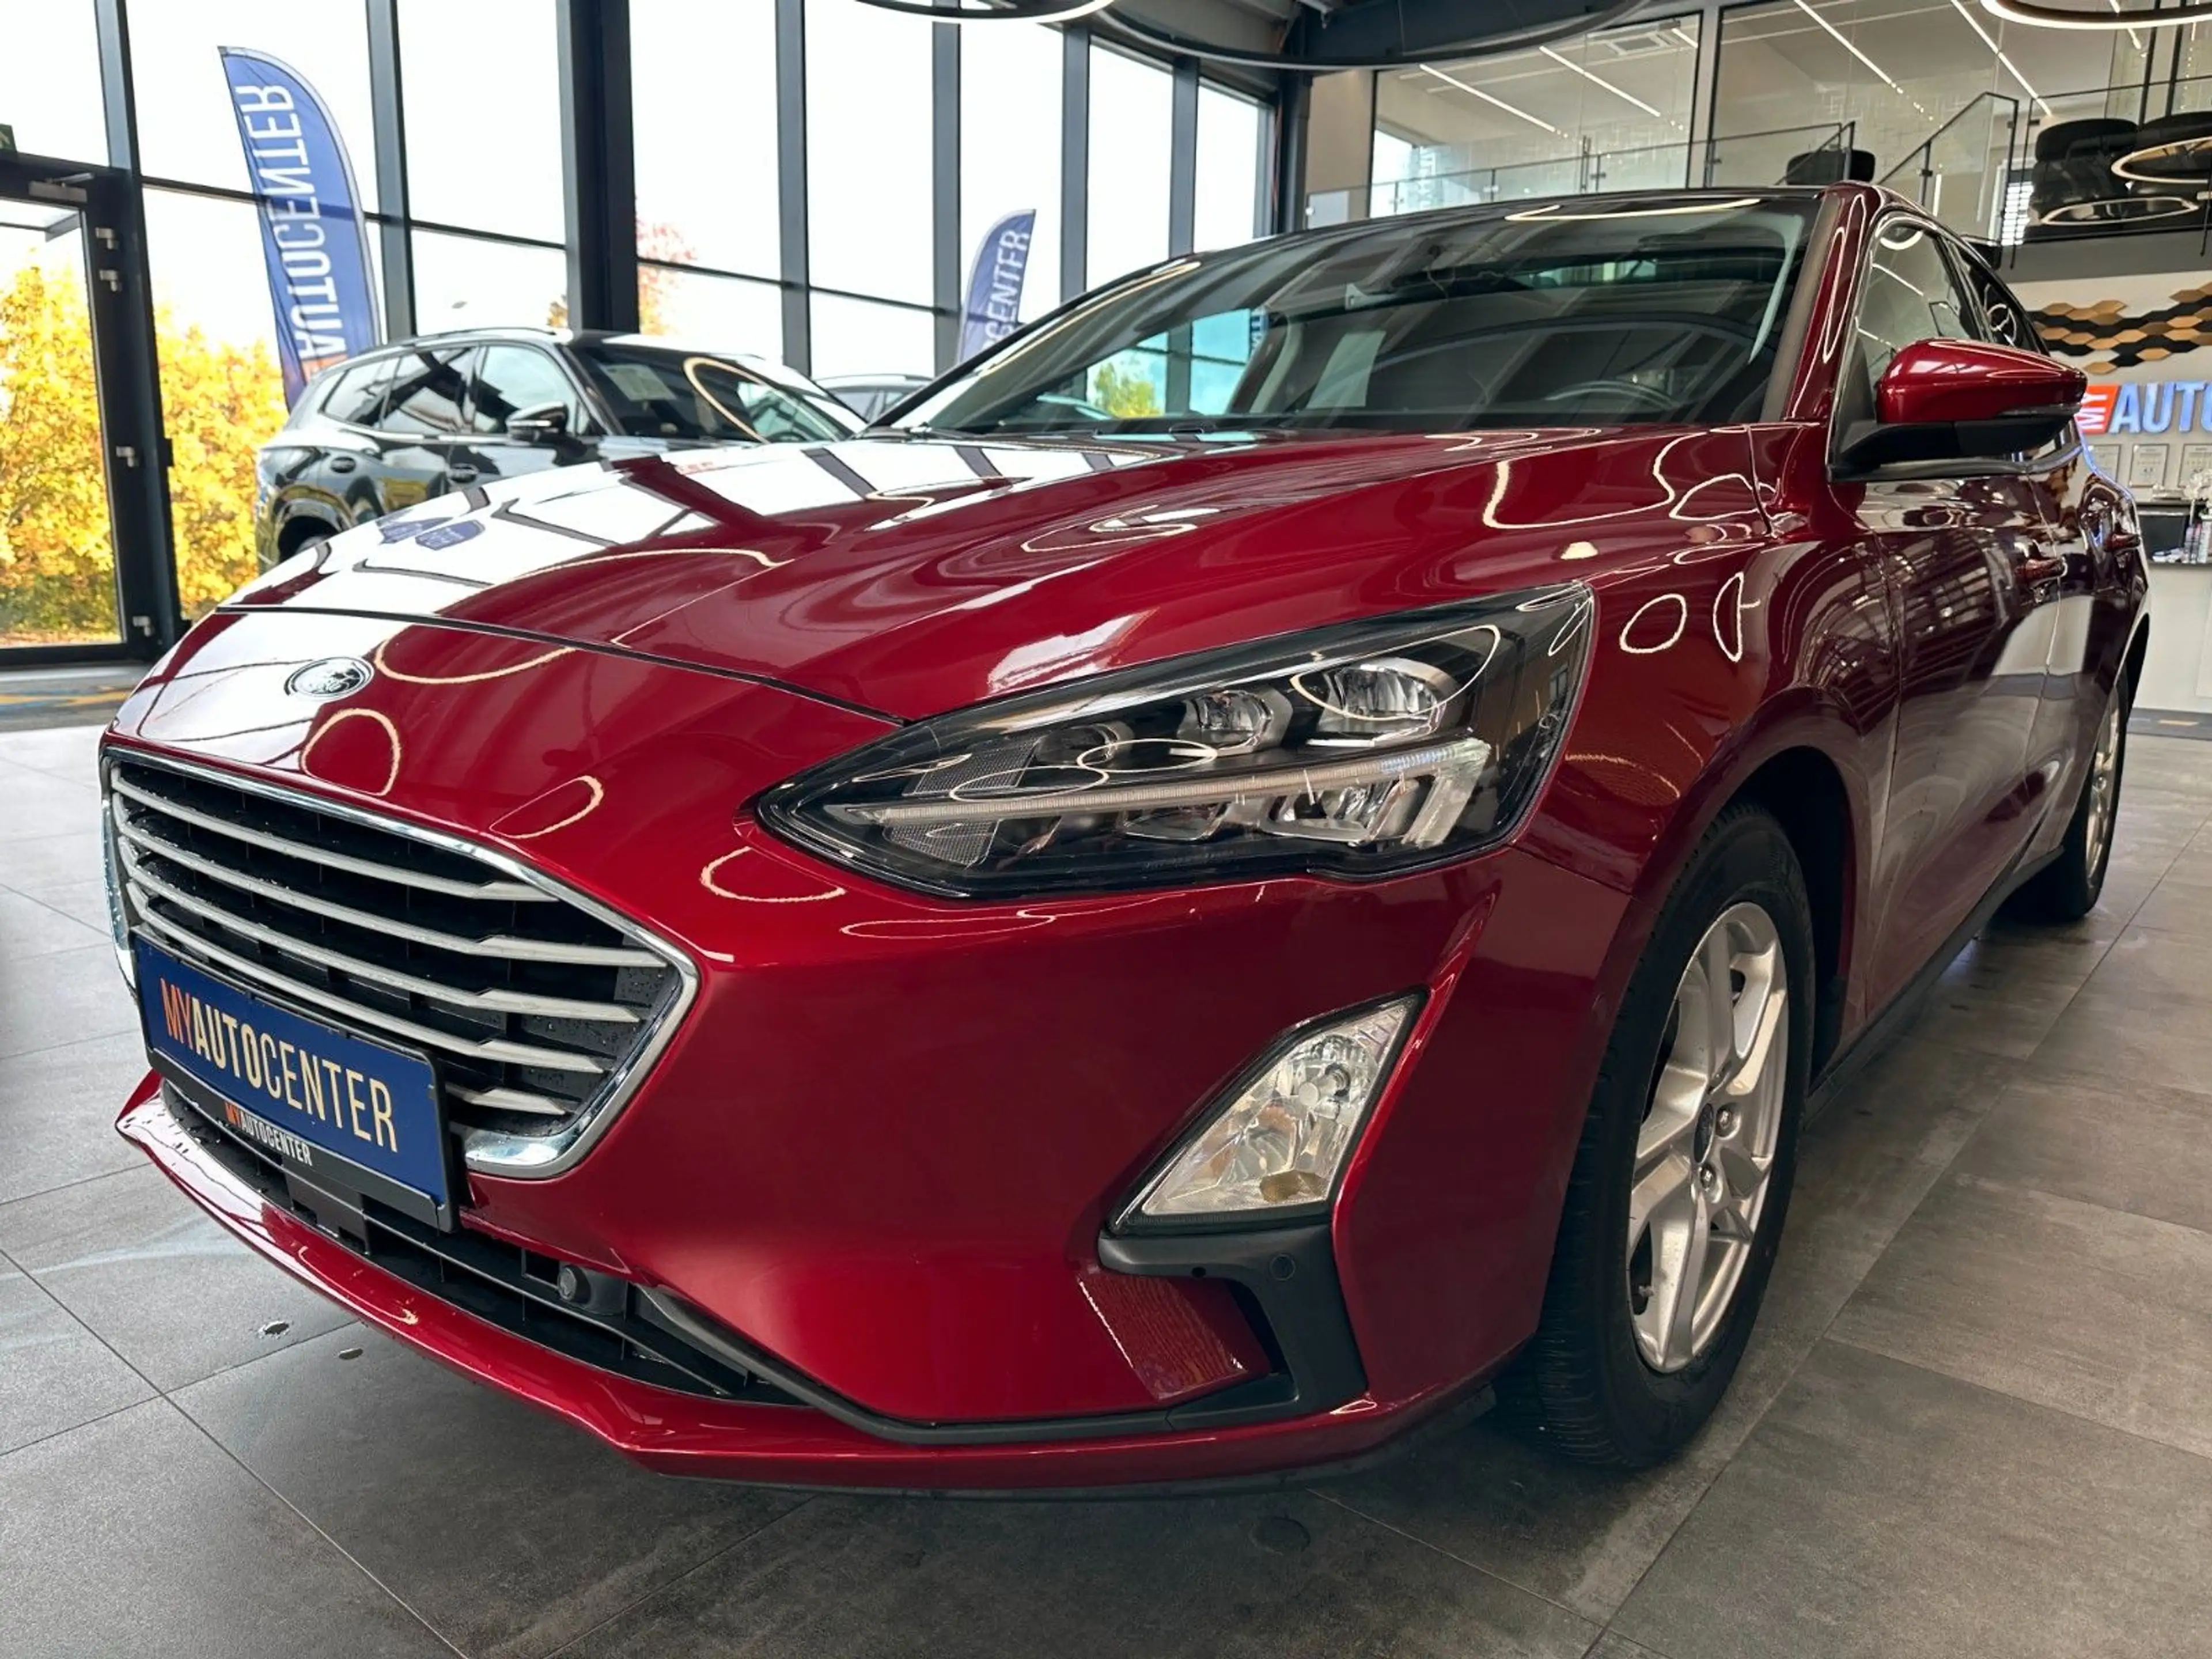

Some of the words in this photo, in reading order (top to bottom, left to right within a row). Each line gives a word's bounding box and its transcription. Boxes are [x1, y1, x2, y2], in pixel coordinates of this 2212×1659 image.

[982, 229, 1030, 349] CENTER
[160, 978, 398, 1153] MYAUTOCENTER
[225, 1101, 312, 1166] MYAUTOCENTER
